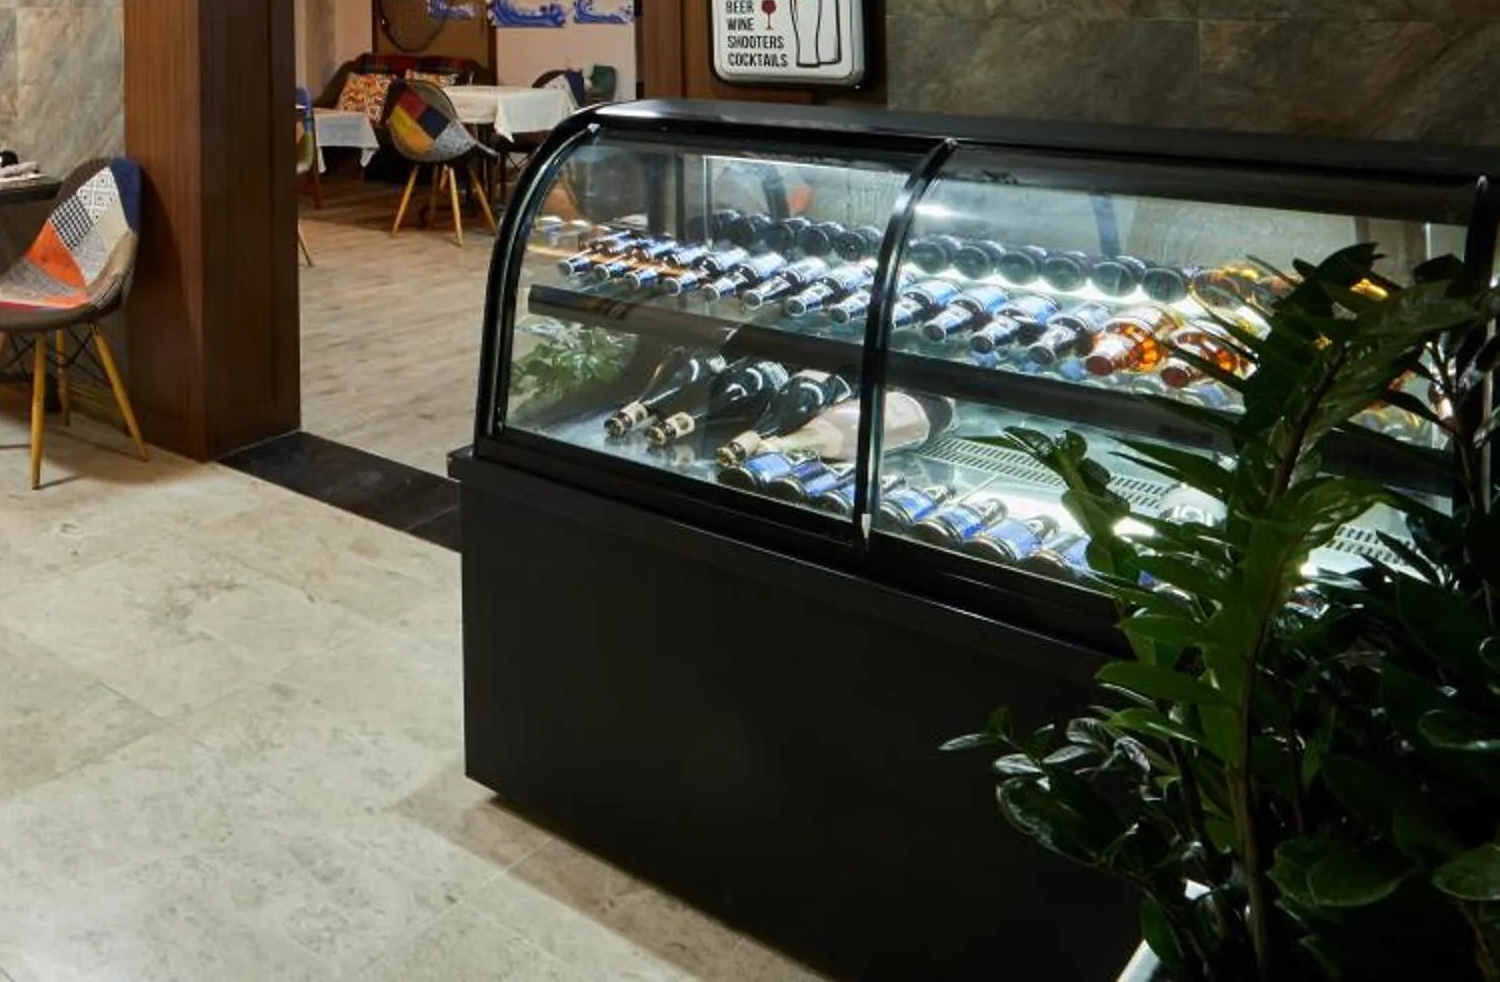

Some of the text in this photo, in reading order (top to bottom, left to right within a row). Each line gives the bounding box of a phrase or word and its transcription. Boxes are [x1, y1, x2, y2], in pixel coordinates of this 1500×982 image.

[725, 0, 755, 15] BEER
[726, 17, 755, 31] WINE
[727, 35, 785, 49] SHOOTERS
[727, 52, 789, 67] COCKTAILS
